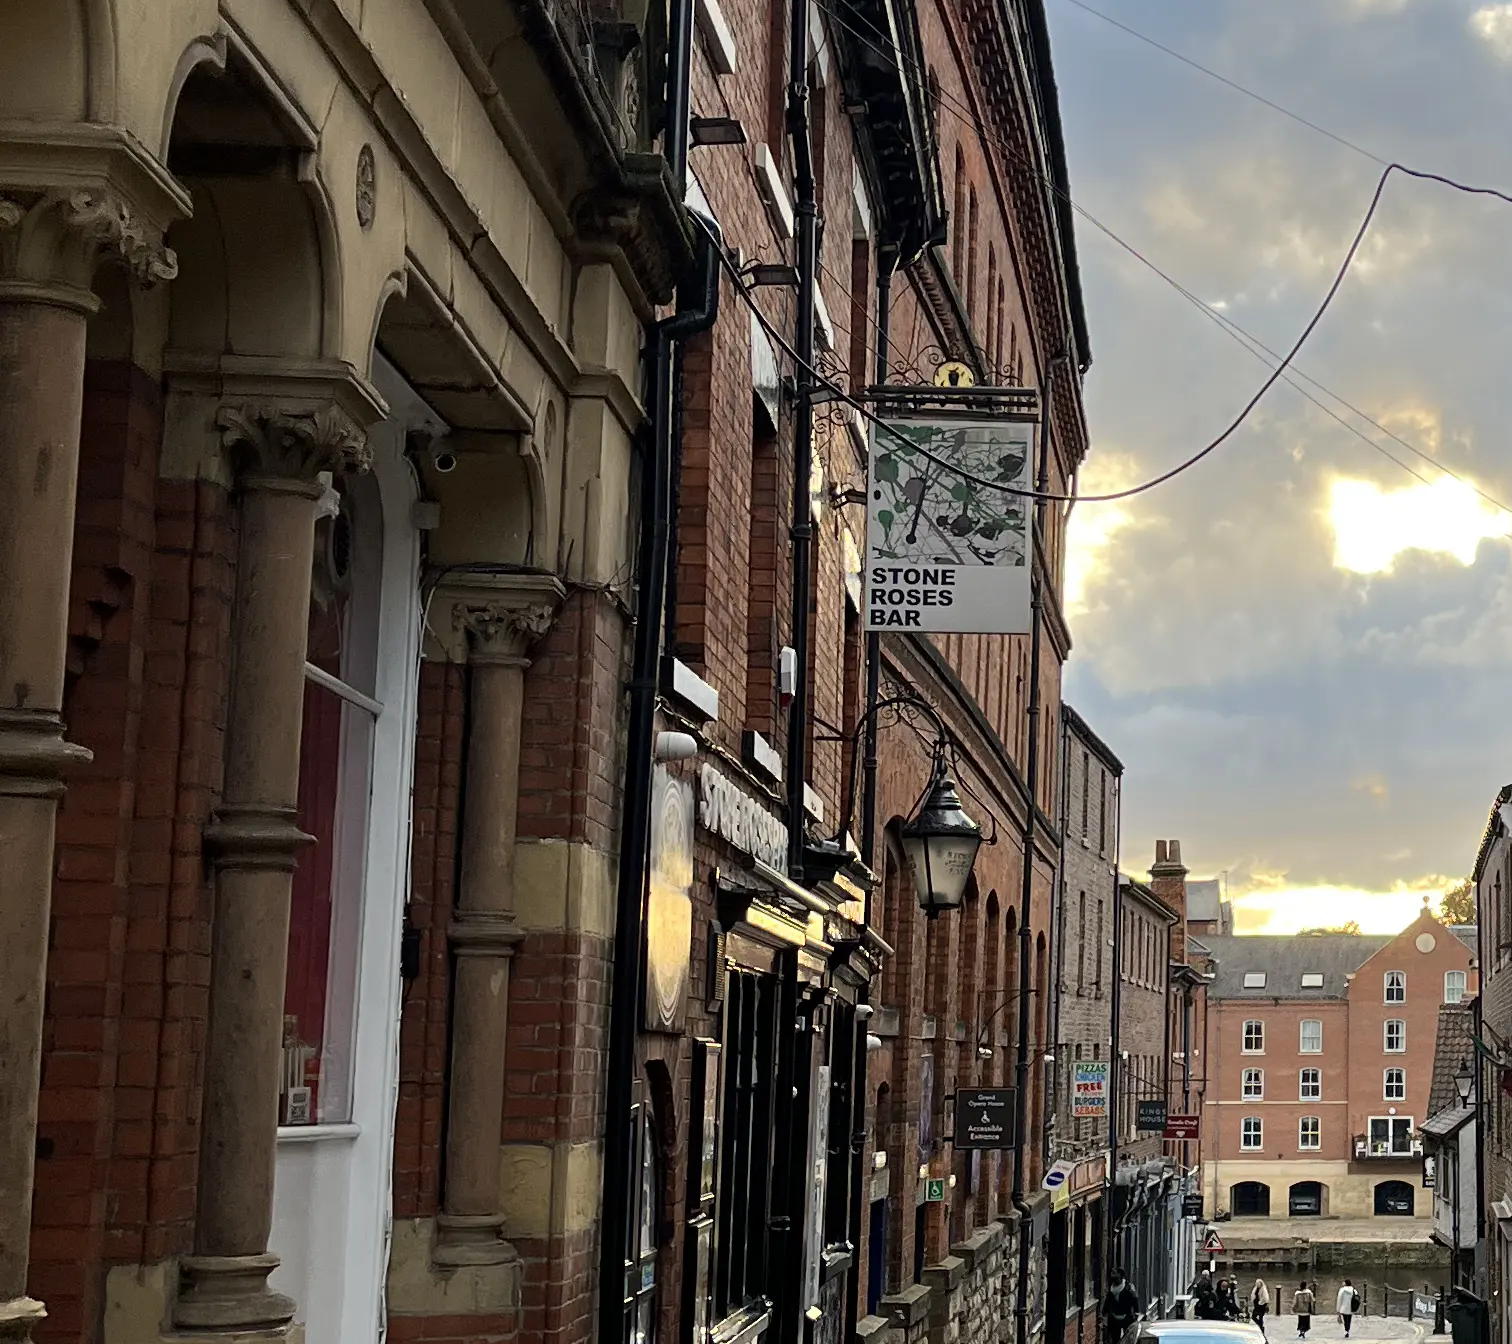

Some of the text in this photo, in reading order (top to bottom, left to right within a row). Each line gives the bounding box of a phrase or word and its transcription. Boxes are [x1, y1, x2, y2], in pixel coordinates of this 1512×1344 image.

[871, 567, 956, 586] STONE
[870, 588, 953, 607] ROSES
[869, 608, 922, 627] BAR
[1075, 1063, 1108, 1073] PIZZAS
[1076, 1082, 1103, 1093] FREE
[970, 1132, 1000, 1140] Entrance
